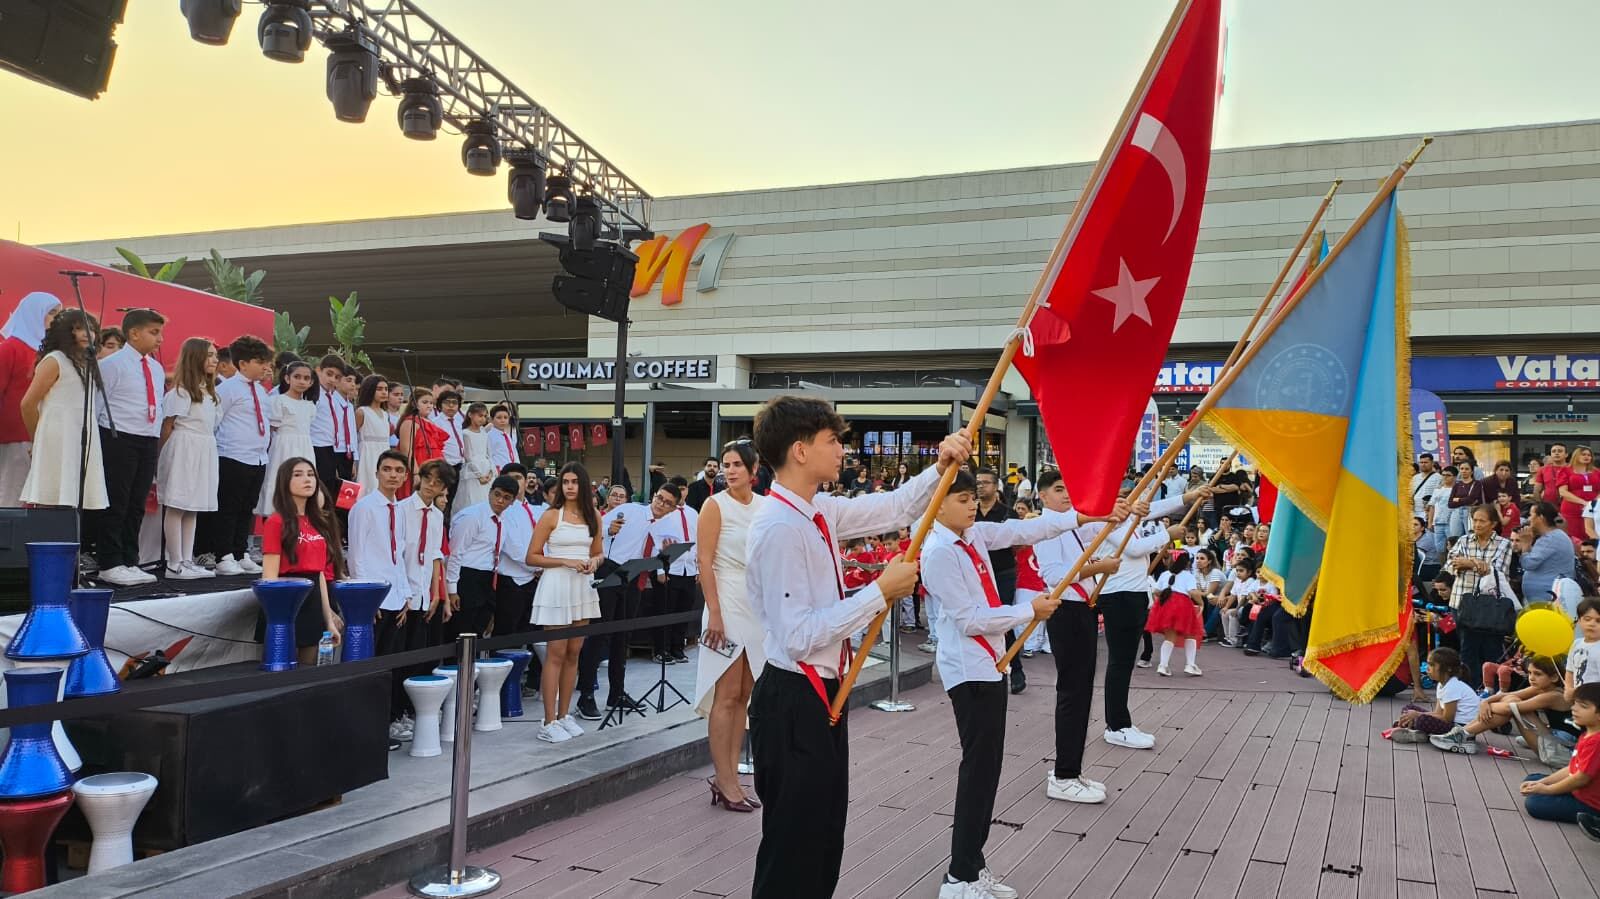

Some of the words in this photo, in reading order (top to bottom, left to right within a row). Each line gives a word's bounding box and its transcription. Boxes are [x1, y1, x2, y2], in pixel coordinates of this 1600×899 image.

[528, 361, 617, 379] SOULMAT
[633, 359, 710, 378] COFFEE
[1154, 362, 1224, 386] ata
[1496, 354, 1600, 381] Vata
